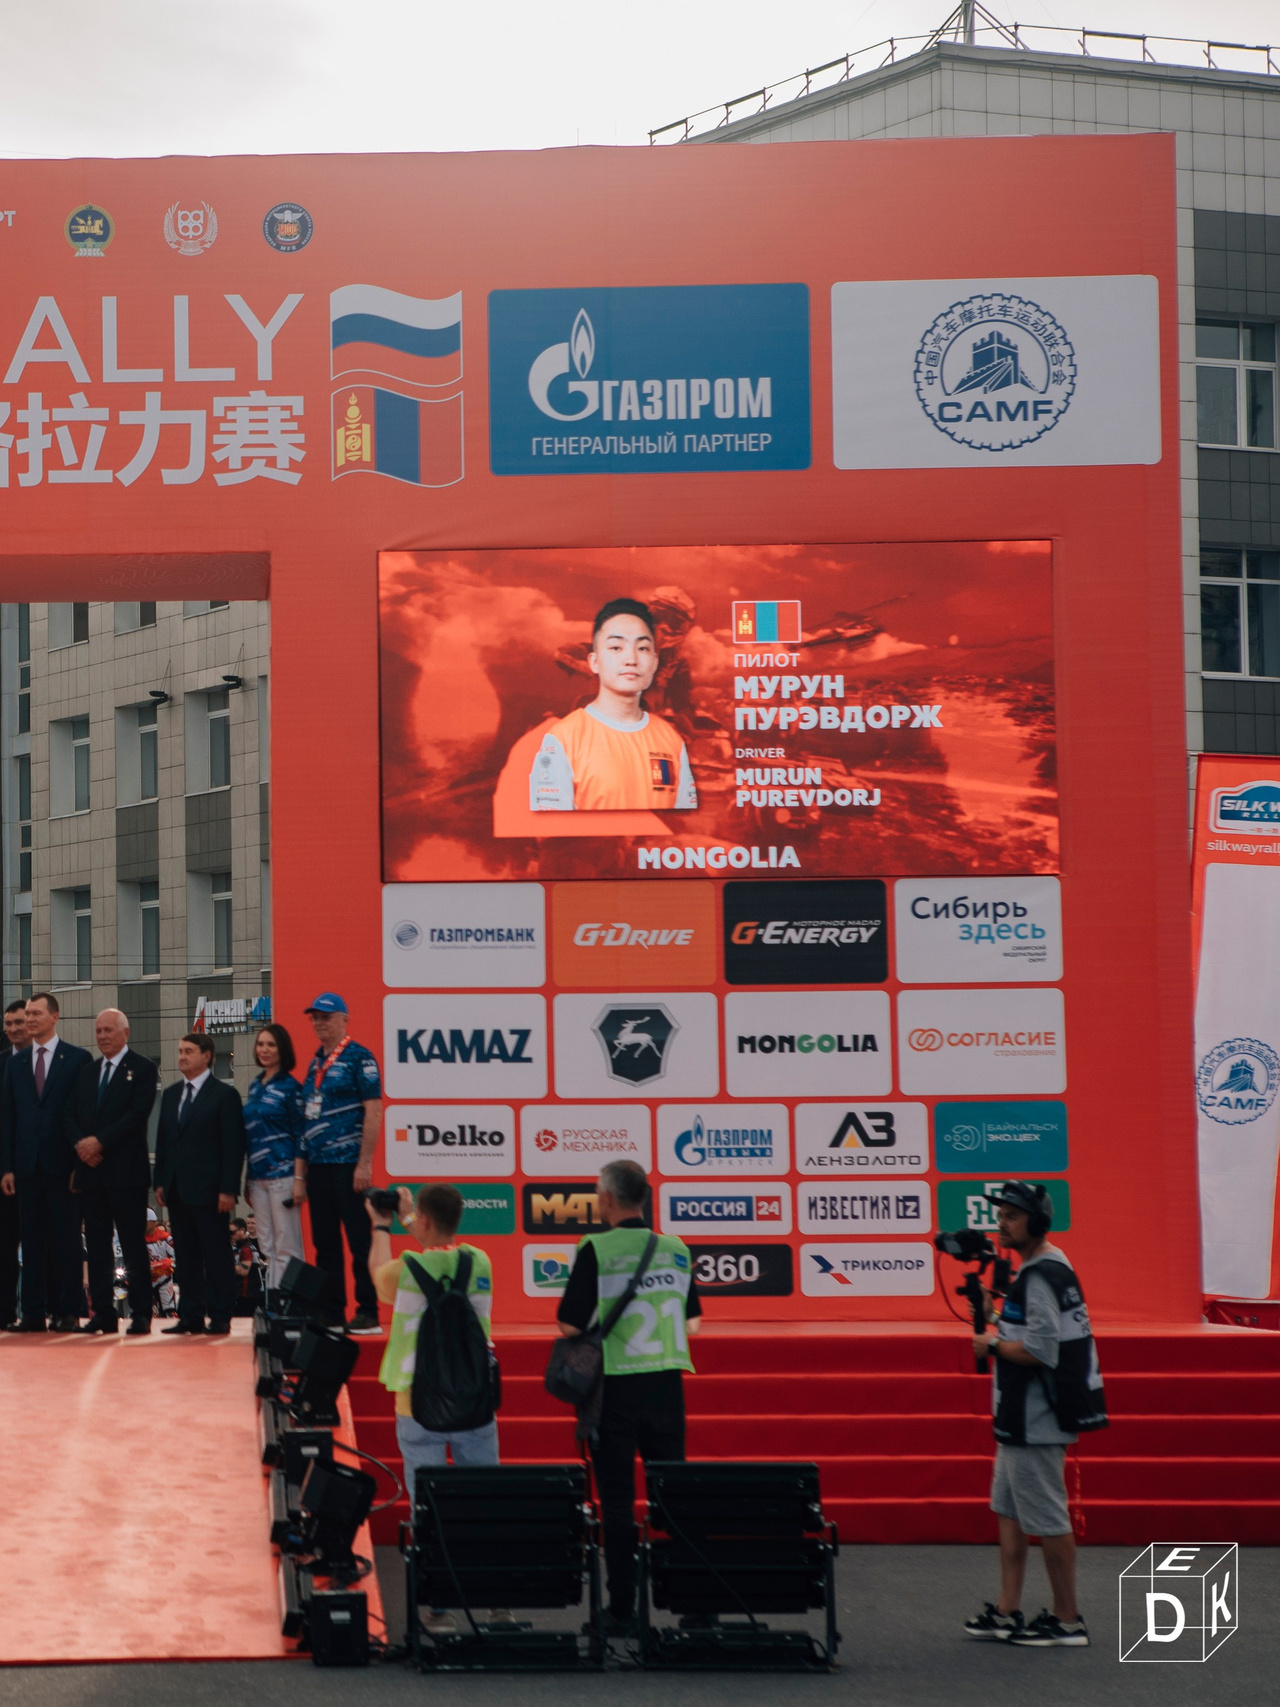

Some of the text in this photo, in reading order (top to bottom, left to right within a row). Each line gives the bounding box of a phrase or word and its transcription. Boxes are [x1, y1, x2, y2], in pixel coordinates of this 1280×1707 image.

[921, 303, 1067, 390] 中国汽车摩托车运动联合会
[600, 376, 773, 423] ГАЗПРОМ
[938, 401, 1055, 425] CAMF
[530, 431, 773, 458] ГЕНЕРАЛЬНЫЙ ПАРТНЕР
[734, 652, 801, 668] ПИЛОТ
[734, 675, 845, 700] МУРУН
[735, 704, 944, 733] ПУРЭВДОРЖ
[735, 747, 786, 759] DRIVER
[736, 767, 822, 786] MURUN
[736, 788, 882, 807] PUREVDORJ
[1221, 799, 1266, 813] SILK
[1241, 812, 1280, 820] RALL
[1206, 839, 1280, 857] silkwayrall
[637, 846, 802, 870] MONGOLIA
[910, 895, 1028, 924] Сибирь
[429, 927, 535, 943] ГАЗПРОМБАНК
[958, 923, 1047, 945] здесь
[396, 1028, 533, 1063] KAMAZ
[737, 1034, 880, 1054] MONGOLIA
[947, 1031, 1057, 1047] СОГЛАСИЕ
[993, 1049, 1057, 1058] страхование
[1201, 1095, 1268, 1111] CAMF
[415, 1124, 505, 1146] Delko
[562, 1128, 628, 1140] РУССКАЯ
[986, 1122, 1059, 1132] БАЙКАЛЬСК
[562, 1140, 639, 1153] МЕХАНИКА
[706, 1128, 773, 1146] ГАЗПРОМ
[986, 1133, 1041, 1142] ЭКО.ЦЕХ
[804, 1155, 921, 1167] ЛЕНЗОЛОТО
[676, 1200, 780, 1217] РОССИЯ 24
[808, 1195, 891, 1220] ИЗВЕСТИЯ
[896, 1195, 921, 1219] iz
[697, 1254, 761, 1283] 360
[841, 1259, 926, 1271] ТРИКОЛОР
[622, 1297, 688, 1358] 21
